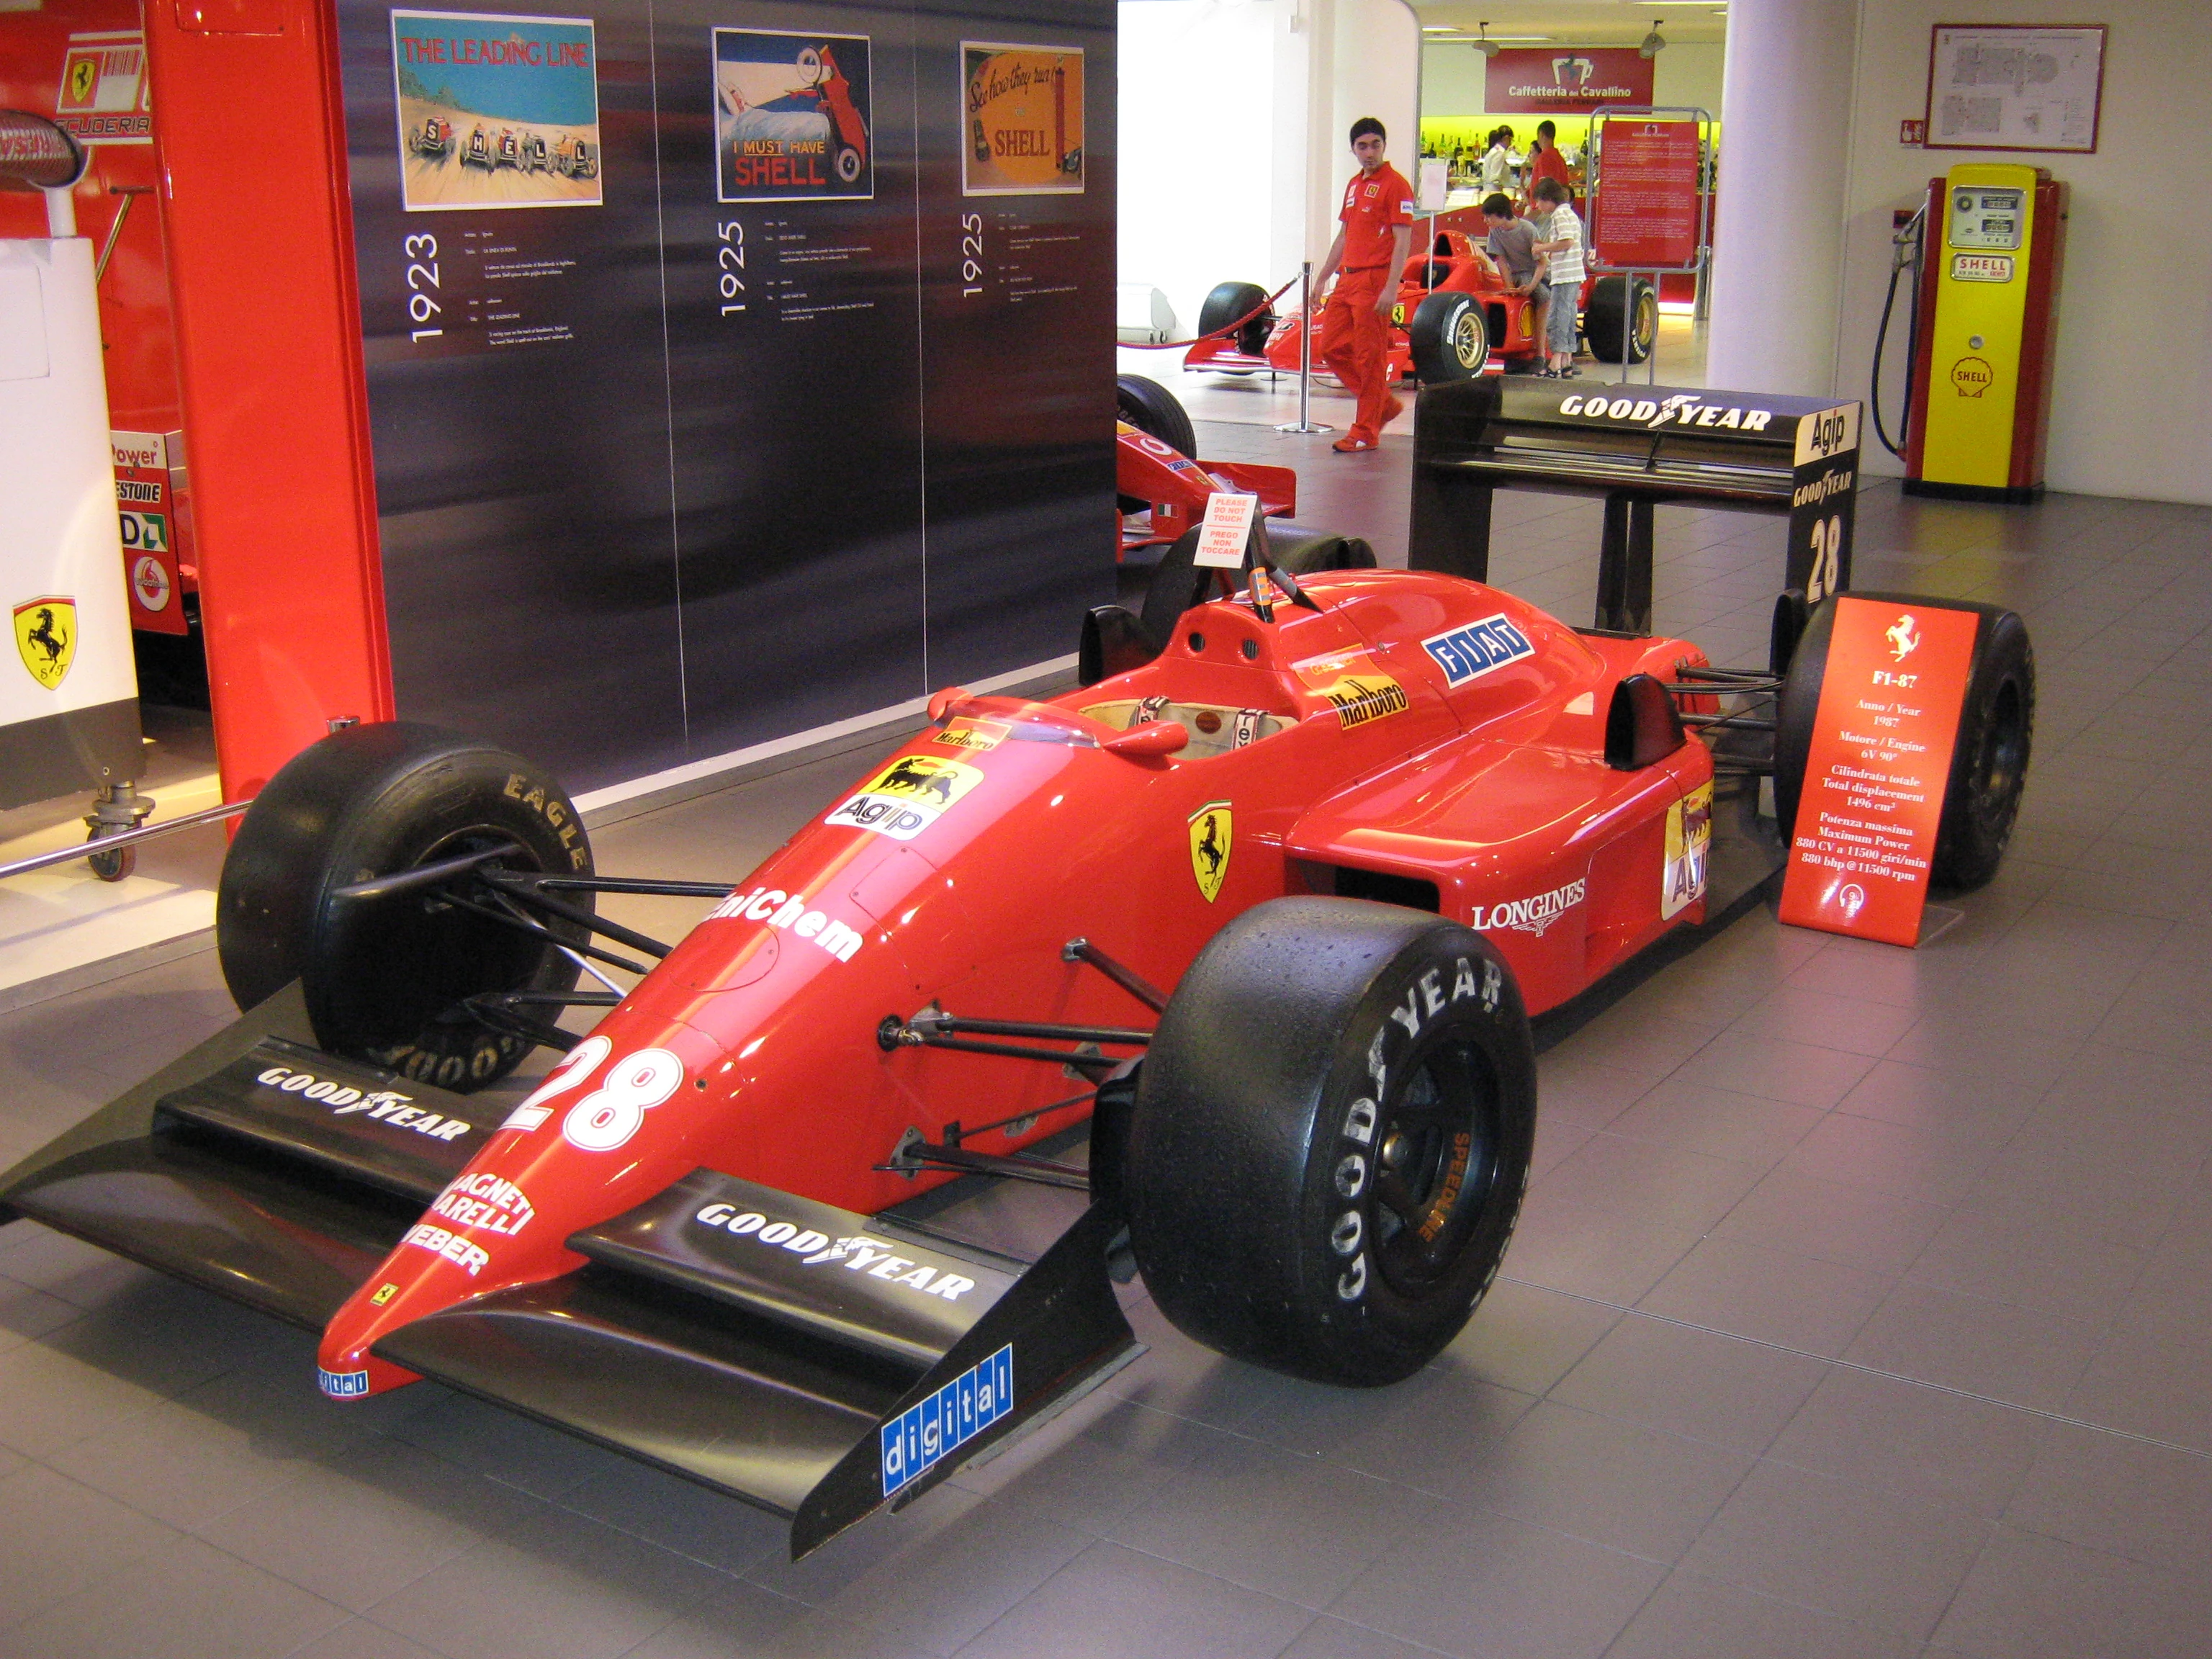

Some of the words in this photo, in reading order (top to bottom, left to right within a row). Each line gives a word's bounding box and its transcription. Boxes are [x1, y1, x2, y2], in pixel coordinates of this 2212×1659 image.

[401, 37, 446, 63] THE
[451, 40, 541, 66] LEADING
[546, 42, 589, 67] LINE
[1509, 86, 1567, 97] Caffetteria
[1581, 86, 1632, 97] Cavallino
[55, 116, 150, 134] SCUDERIA
[733, 142, 737, 153] I
[745, 141, 783, 155] MUST
[791, 141, 824, 153] HAVE
[994, 130, 1050, 156] SHELL
[734, 158, 825, 186] SHELL
[962, 213, 983, 298] 1925
[1959, 259, 2005, 271] SHELL
[718, 222, 746, 317] 1925
[405, 233, 444, 343] 1923
[1957, 372, 1987, 382] SHELL
[1811, 409, 1844, 456] Agip
[1215, 498, 1248, 507] PLEASE
[1213, 514, 1242, 523] TOUCH
[1201, 547, 1240, 555] TOCCARE
[1807, 515, 1841, 604] 28
[1436, 624, 1519, 673] FIAT
[1872, 670, 1917, 688] F1-87
[1329, 680, 1407, 727] Marlboro
[1856, 699, 1885, 712] Anno
[1887, 703, 1894, 713] /
[1896, 704, 1921, 716] Year
[1873, 715, 1899, 728] 1987
[936, 728, 994, 750] Marlboro
[1838, 730, 1877, 745] Motore
[1879, 737, 1885, 747] /
[1887, 737, 1926, 753] Engine
[1861, 749, 1877, 759] 6V
[1879, 752, 1898, 762] 90°
[1831, 765, 1886, 782] Cilindrata
[1889, 775, 1920, 787] totale
[1822, 777, 1848, 791] Total
[1851, 783, 1924, 802] displacement
[834, 796, 922, 831] Agip
[1847, 796, 1872, 809] 1496
[503, 773, 587, 870] EAGLE
[1820, 811, 1863, 828] Potenza
[1864, 822, 1913, 836] massima
[1817, 827, 1872, 844] Maximum
[1874, 835, 1910, 850] Power
[1796, 837, 1815, 849] 880
[1818, 841, 1835, 852] CV
[1847, 845, 1879, 860] 11500
[1880, 852, 1927, 868] giri/min
[1802, 853, 1821, 865] 880
[1824, 856, 1845, 871] bhp
[1846, 860, 1856, 871] @
[1858, 862, 1889, 876] 11500
[1892, 871, 1916, 882] rpm
[1472, 877, 1586, 930] LONGINES
[498, 1035, 684, 1152] 28
[886, 1365, 1006, 1476] digital
